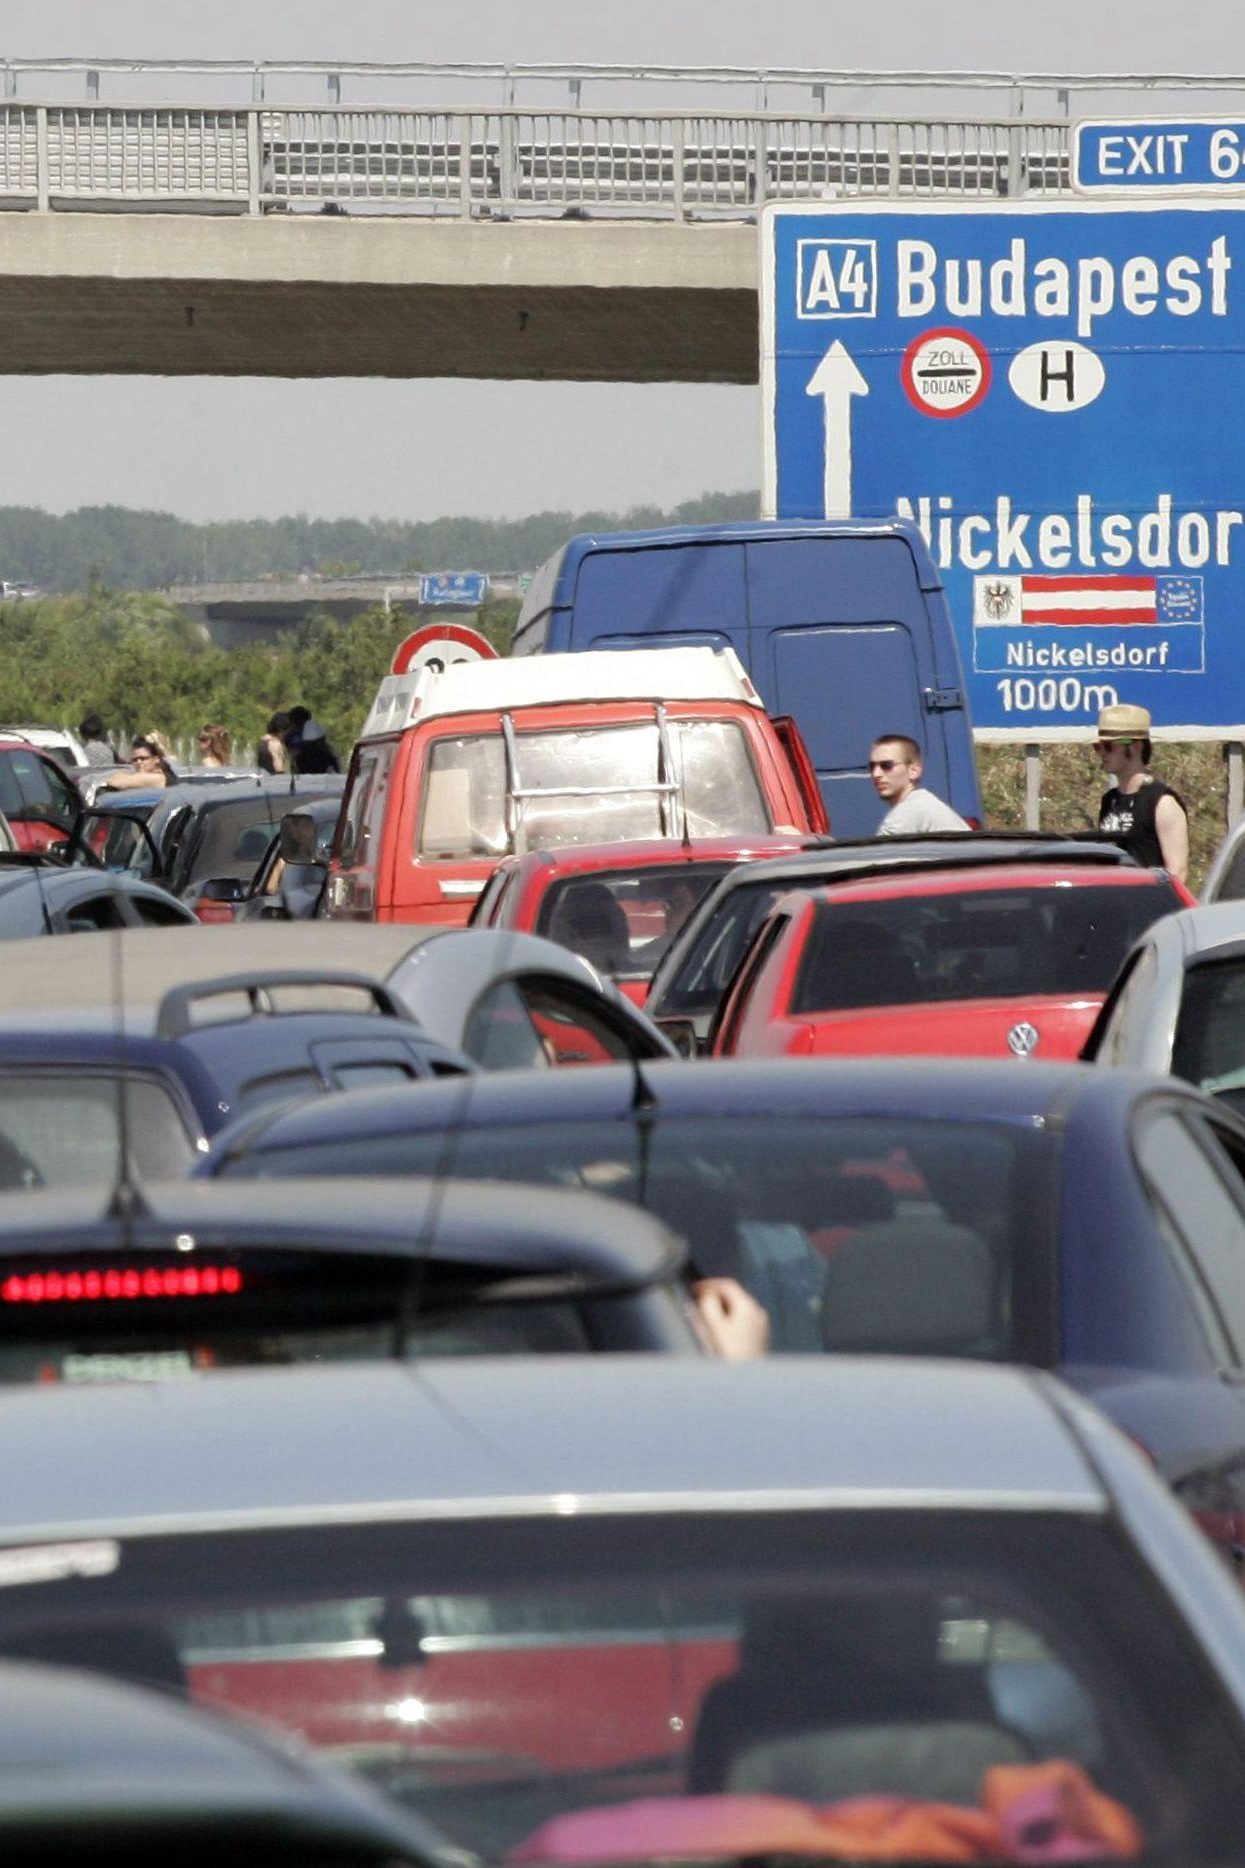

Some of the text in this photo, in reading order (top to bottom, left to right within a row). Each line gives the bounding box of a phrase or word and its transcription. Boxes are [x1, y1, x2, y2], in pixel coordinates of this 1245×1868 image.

[1098, 129, 1245, 178] EXIT 6
[806, 249, 868, 309] A4
[897, 235, 1232, 338] Budapest
[927, 350, 969, 368] ZOLL
[1040, 350, 1075, 402] H
[922, 379, 973, 396] DOUANE
[1006, 640, 1170, 667] Nickelsdorf
[996, 678, 1119, 712] 1000m
